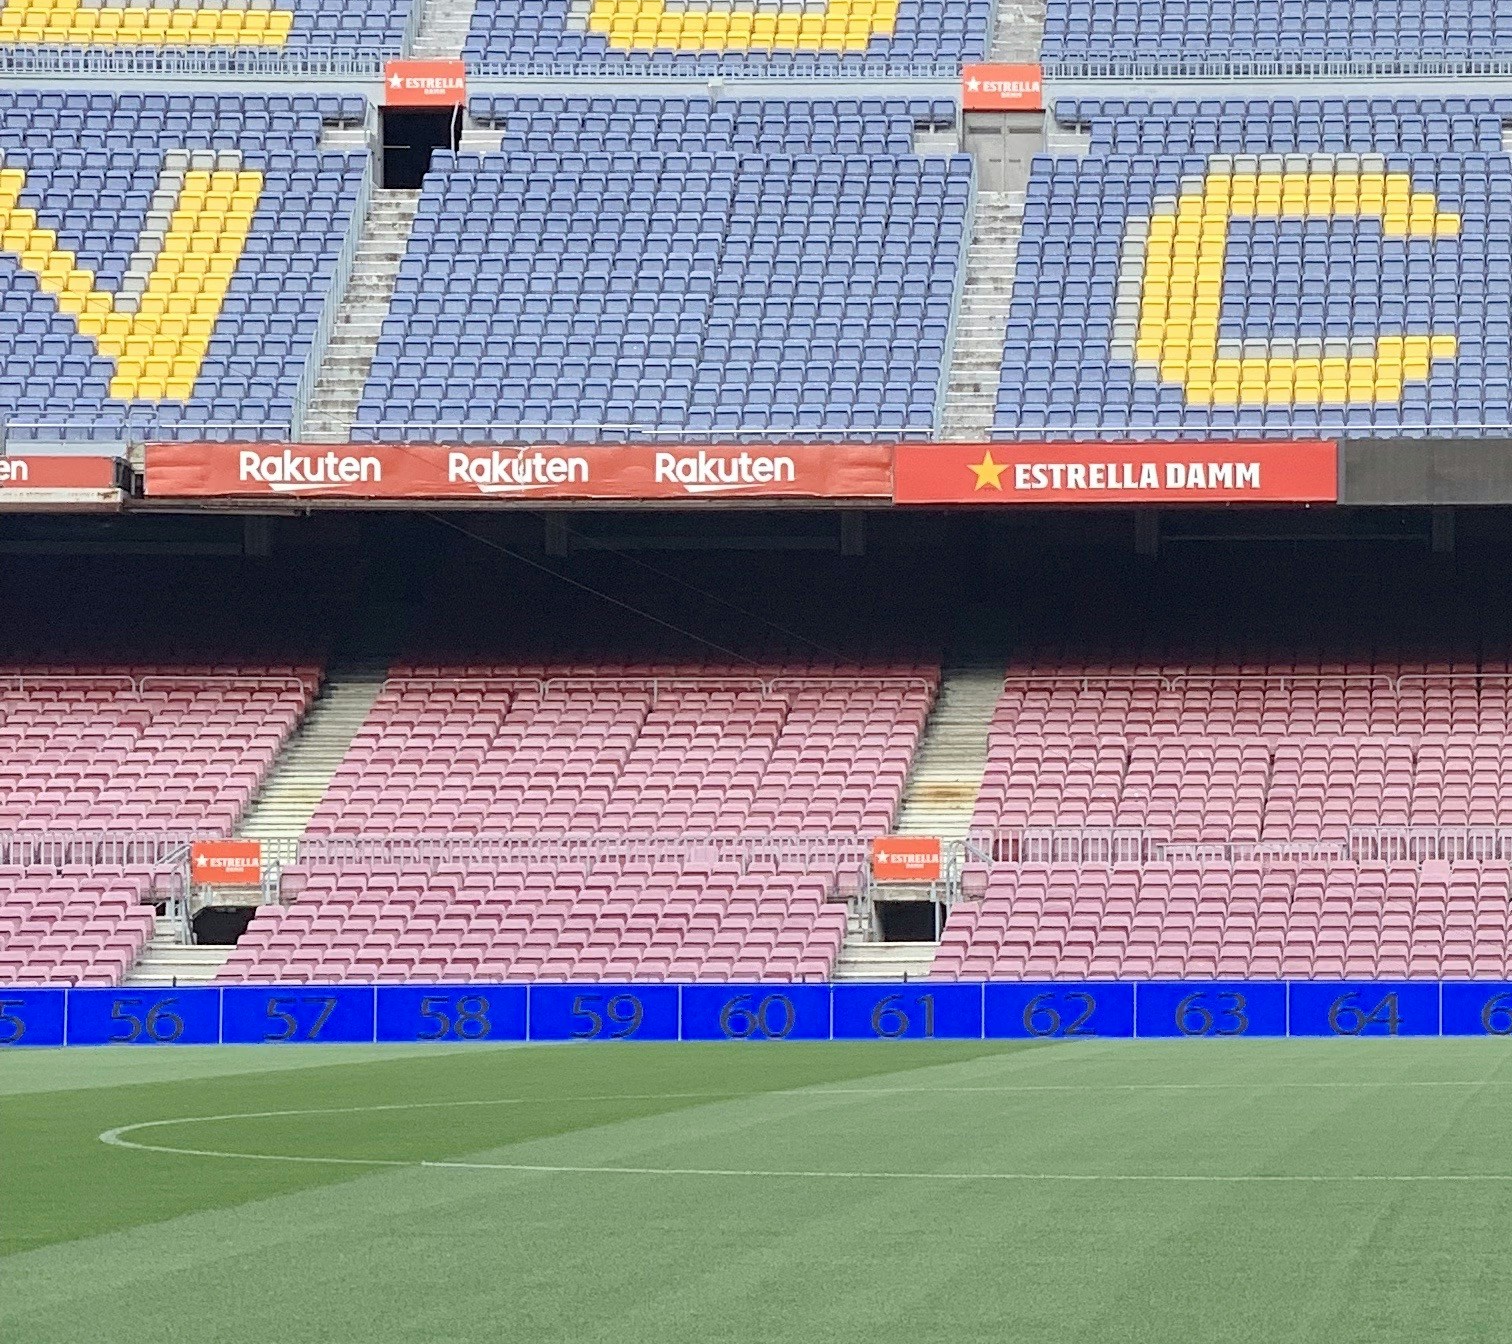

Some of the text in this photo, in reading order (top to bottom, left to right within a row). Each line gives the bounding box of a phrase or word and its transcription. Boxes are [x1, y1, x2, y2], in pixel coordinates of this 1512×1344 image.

[405, 77, 464, 89] ESTRELLA
[982, 81, 1040, 93] ESTRELLA
[238, 449, 382, 482] Rakuten
[448, 451, 589, 483] Rakuten
[655, 450, 796, 483] Rakuten
[1014, 462, 1261, 489] ESTRELLA DAMM
[210, 857, 260, 867] ESTRELLA
[890, 853, 940, 863] ESTRELLA
[110, 997, 185, 1042] 56
[264, 997, 337, 1041] 57
[417, 995, 491, 1040] 58
[569, 994, 643, 1039] 59
[719, 994, 795, 1039] 60
[871, 994, 935, 1038] 61
[1023, 992, 1097, 1037] 62
[1175, 992, 1249, 1037] 63
[1328, 992, 1404, 1036] 64
